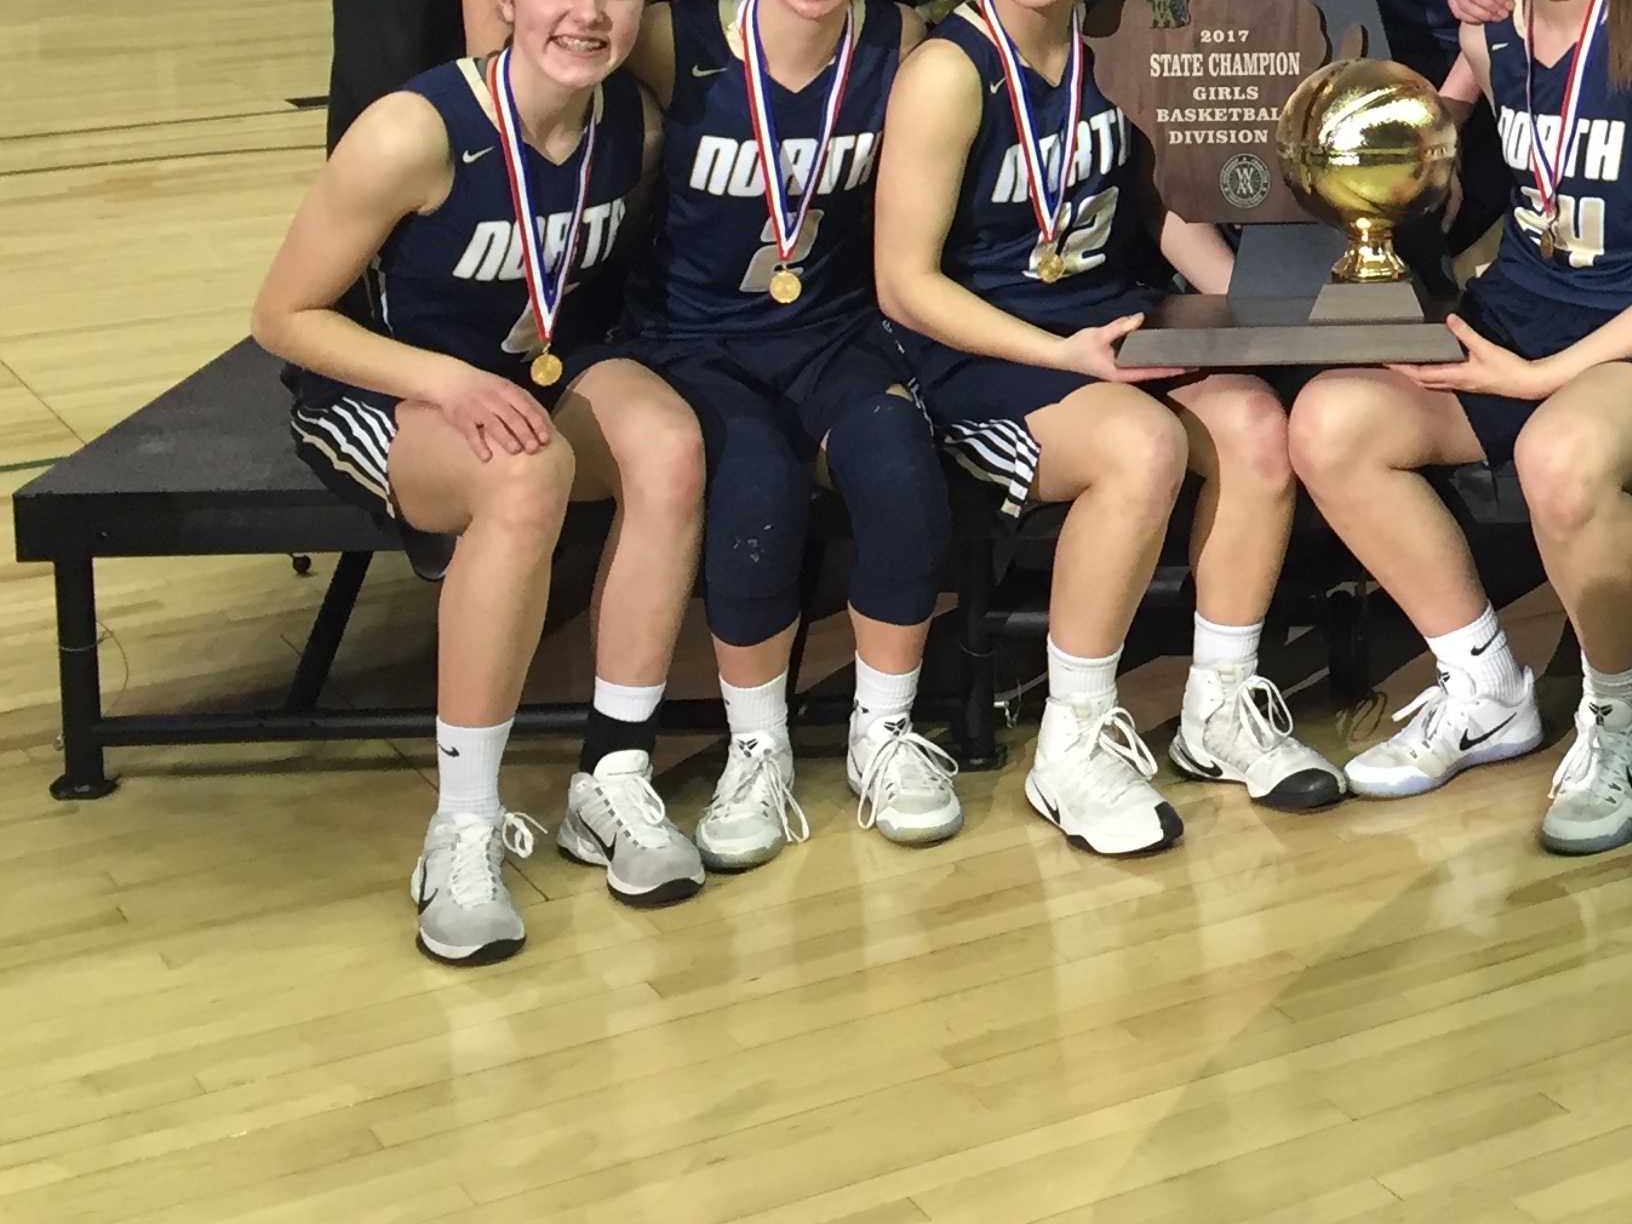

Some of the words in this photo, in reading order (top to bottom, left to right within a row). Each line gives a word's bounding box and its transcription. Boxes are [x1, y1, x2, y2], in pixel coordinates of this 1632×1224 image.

[1200, 29, 1250, 43] 2017
[1149, 52, 1204, 77] STATE
[1208, 51, 1301, 76] CHAMPION
[1156, 107, 1281, 123] BASKETBAL
[1192, 85, 1259, 101] GIRLS
[1168, 129, 1268, 145] DIVISION
[1498, 104, 1627, 182] NORTH
[689, 131, 885, 198] NORTH
[452, 195, 627, 281] NORTH
[1513, 185, 1606, 269] 24
[738, 208, 826, 293] 2
